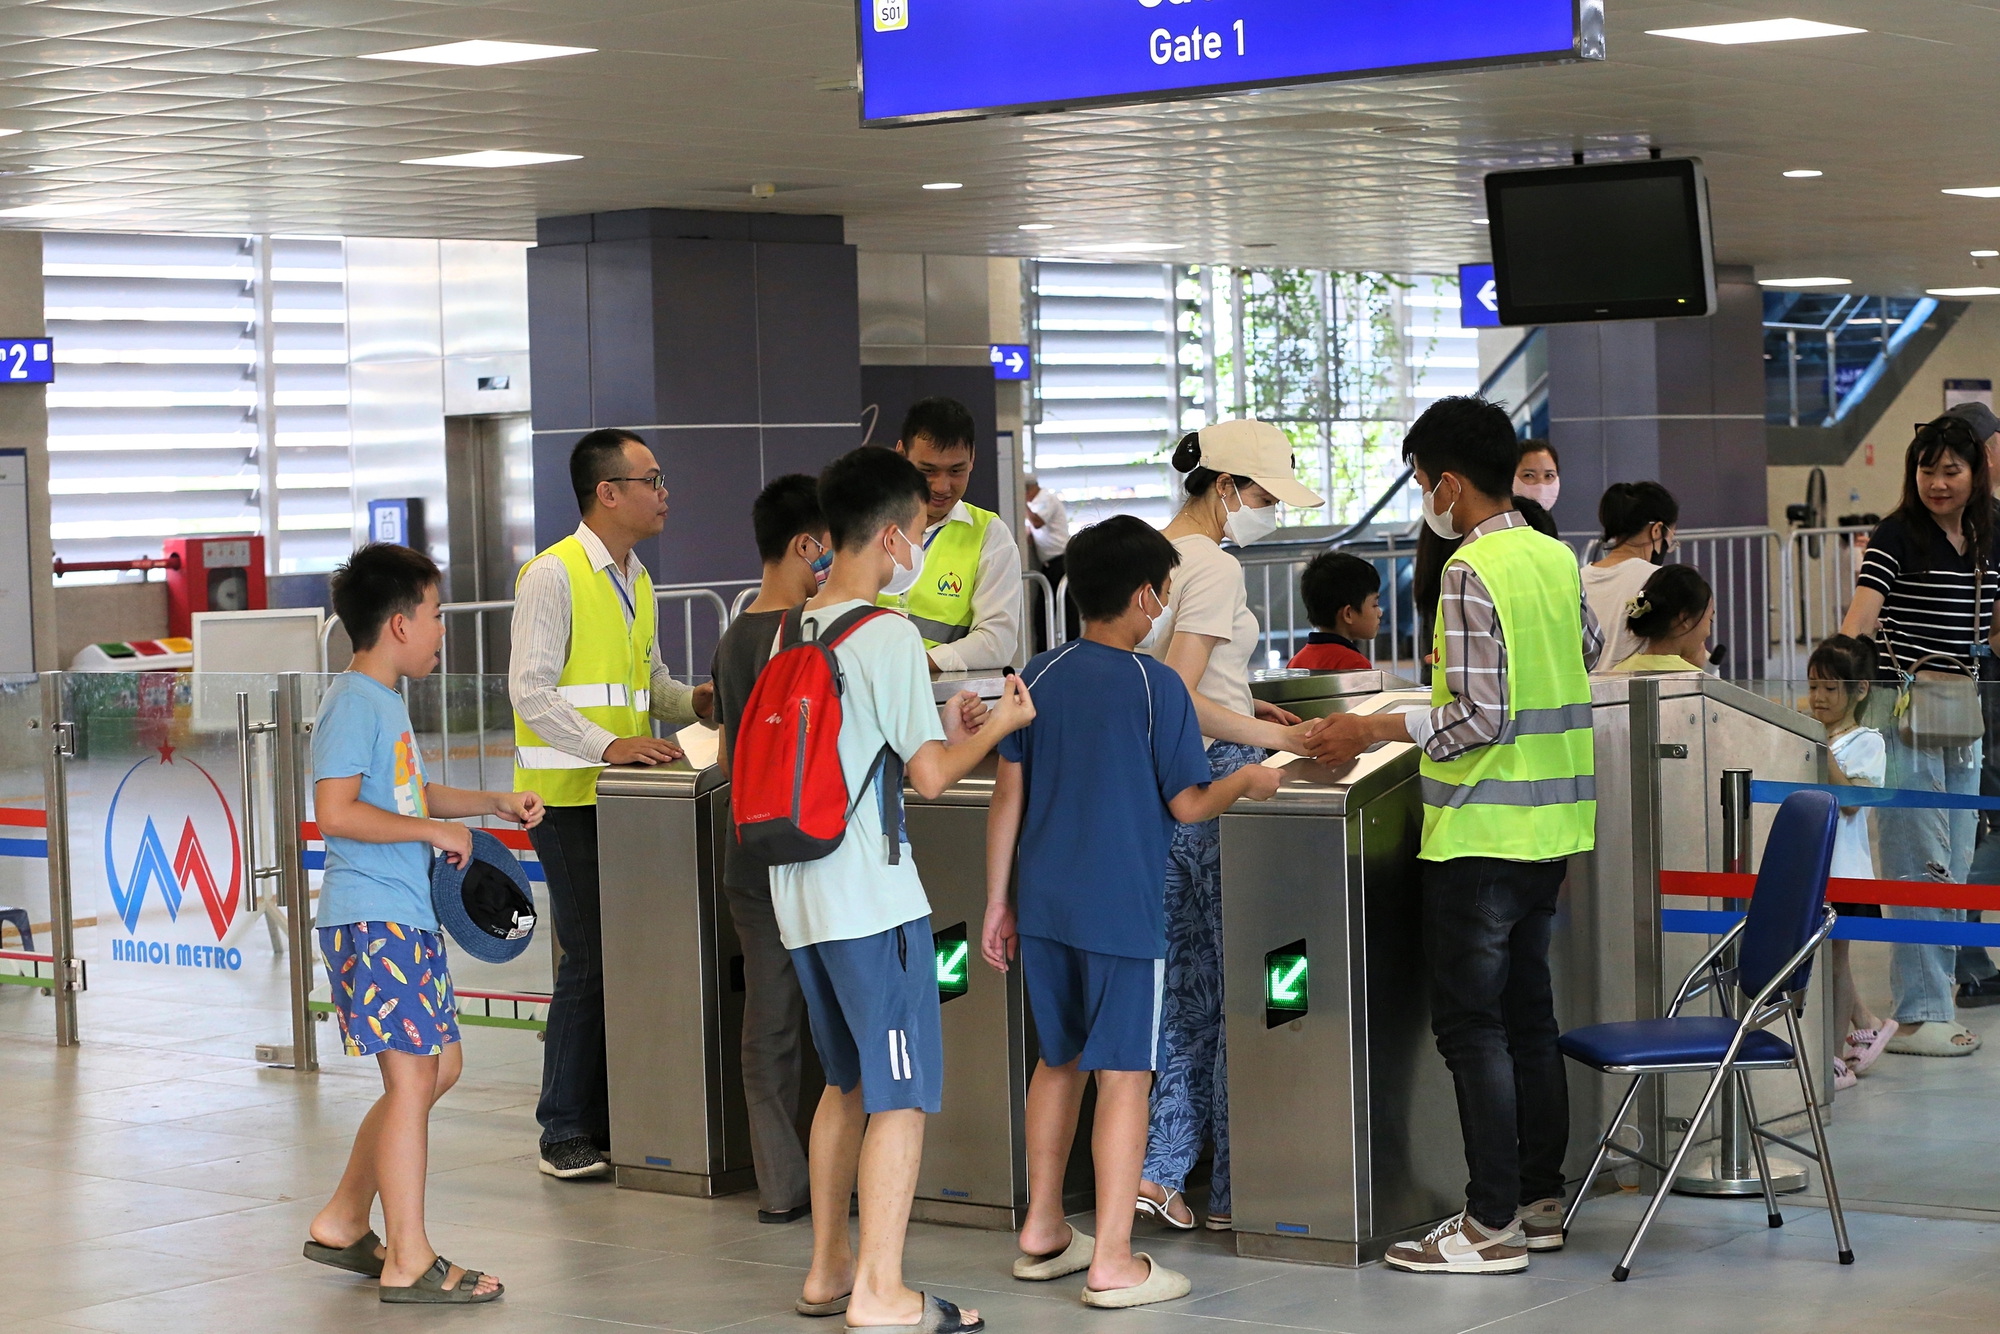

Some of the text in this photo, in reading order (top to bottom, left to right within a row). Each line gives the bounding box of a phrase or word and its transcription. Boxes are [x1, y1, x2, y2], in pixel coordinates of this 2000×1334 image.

[881, 6, 901, 21] S01
[1149, 19, 1245, 65] Gate 1
[9, 343, 28, 379] 2
[112, 939, 242, 971] HANOI METRO
